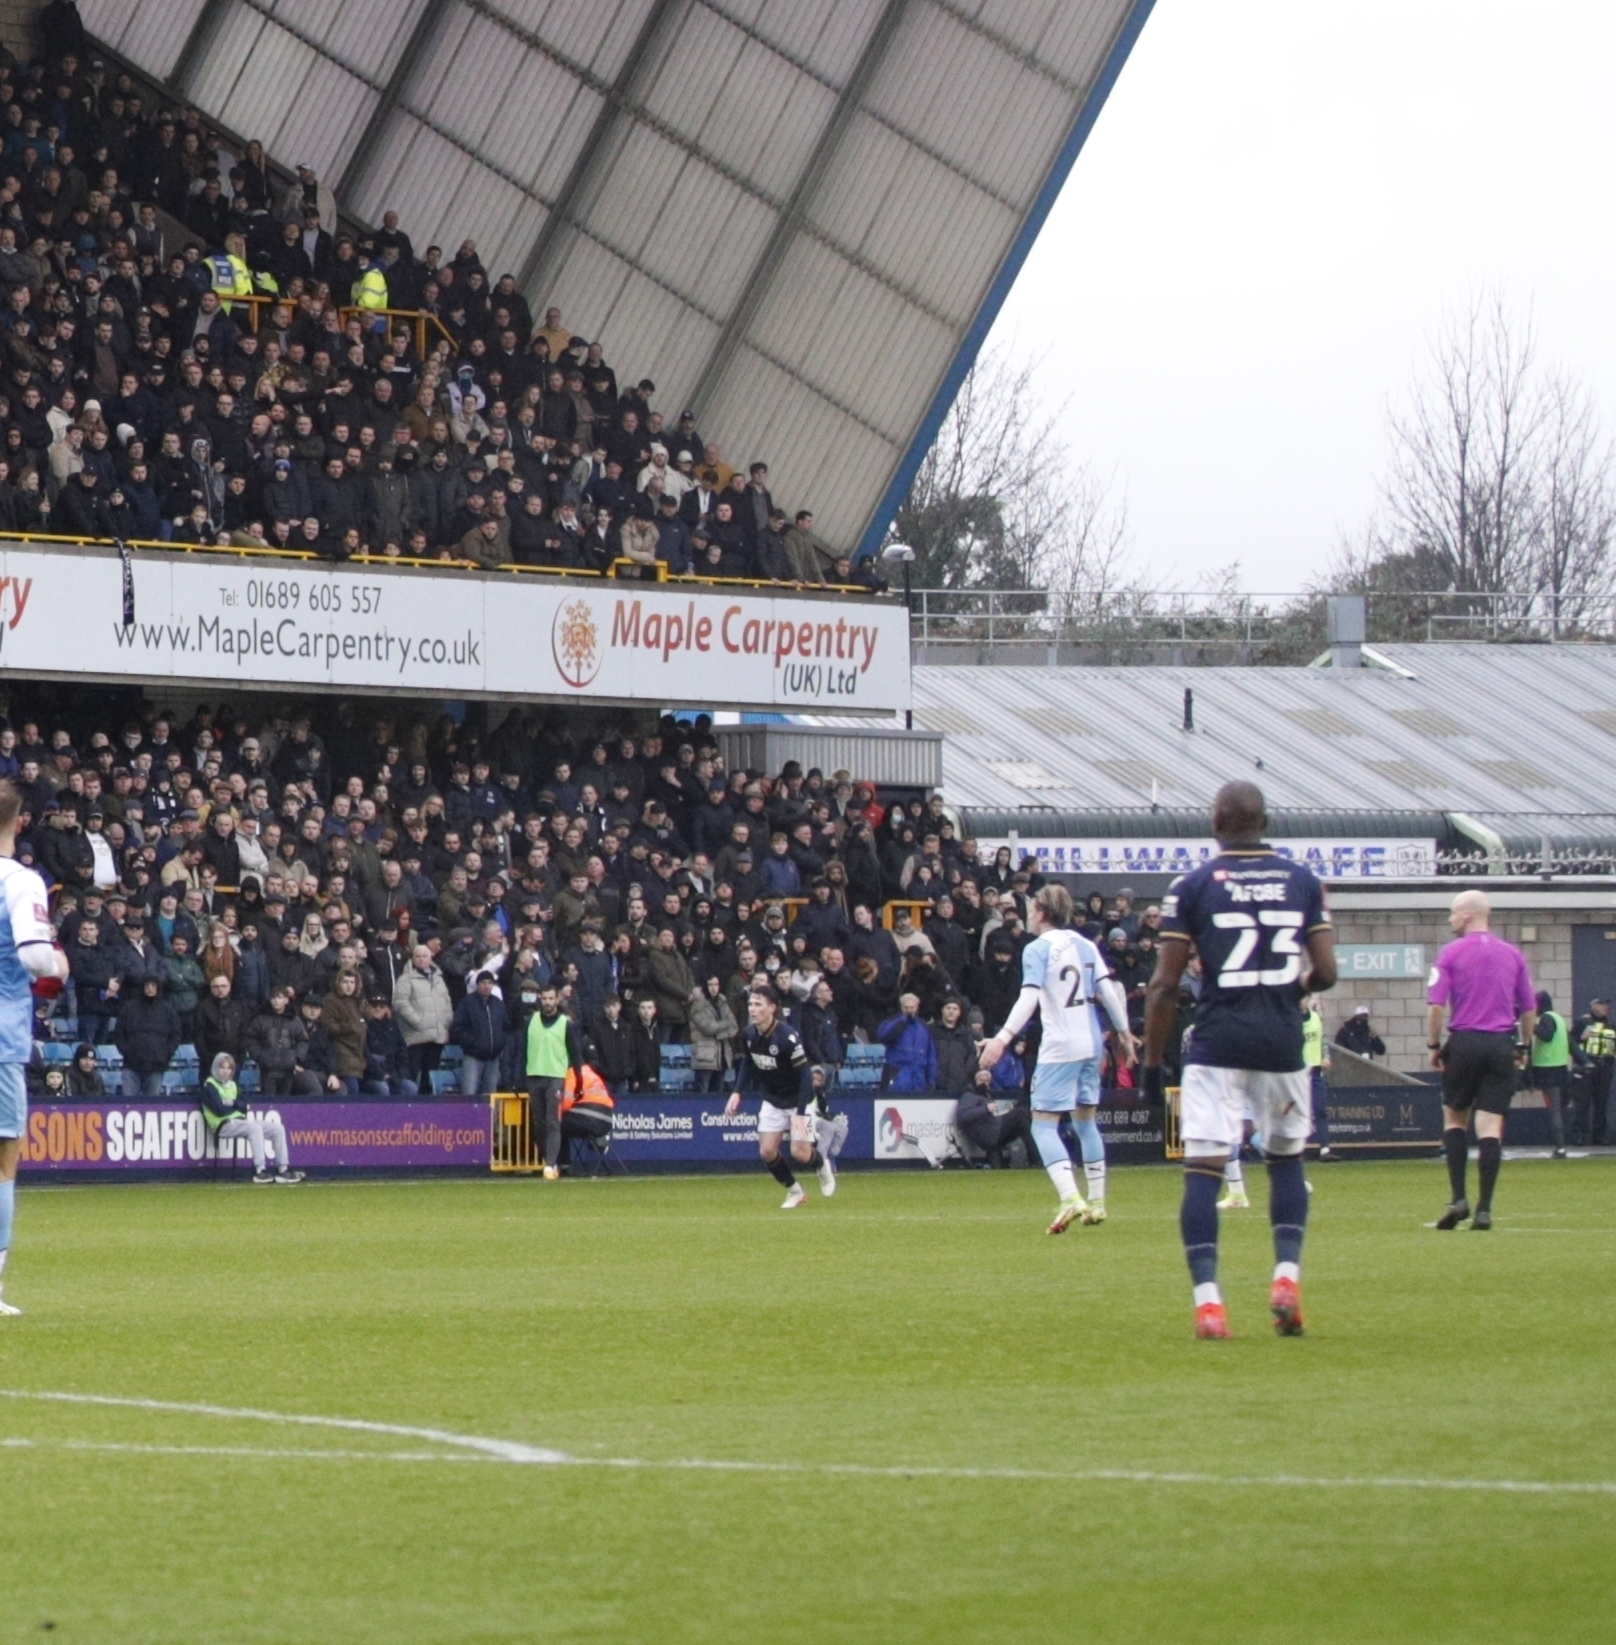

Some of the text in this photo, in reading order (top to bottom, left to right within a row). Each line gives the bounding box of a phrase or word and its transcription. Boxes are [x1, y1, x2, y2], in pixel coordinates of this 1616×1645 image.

[219, 580, 382, 616] Tel: 01689 605 557
[113, 618, 481, 668] www.MapleCarpentry.co.uk
[611, 600, 879, 673] Maple Carpentry
[782, 664, 858, 698] (UK) Ltd
[1018, 846, 1209, 872] MILLWA
[1212, 909, 1305, 989] 23
[1353, 951, 1398, 971] EXIT
[290, 1122, 485, 1152] www.masonsscaffolding.com
[611, 1113, 693, 1130] Nicholas James
